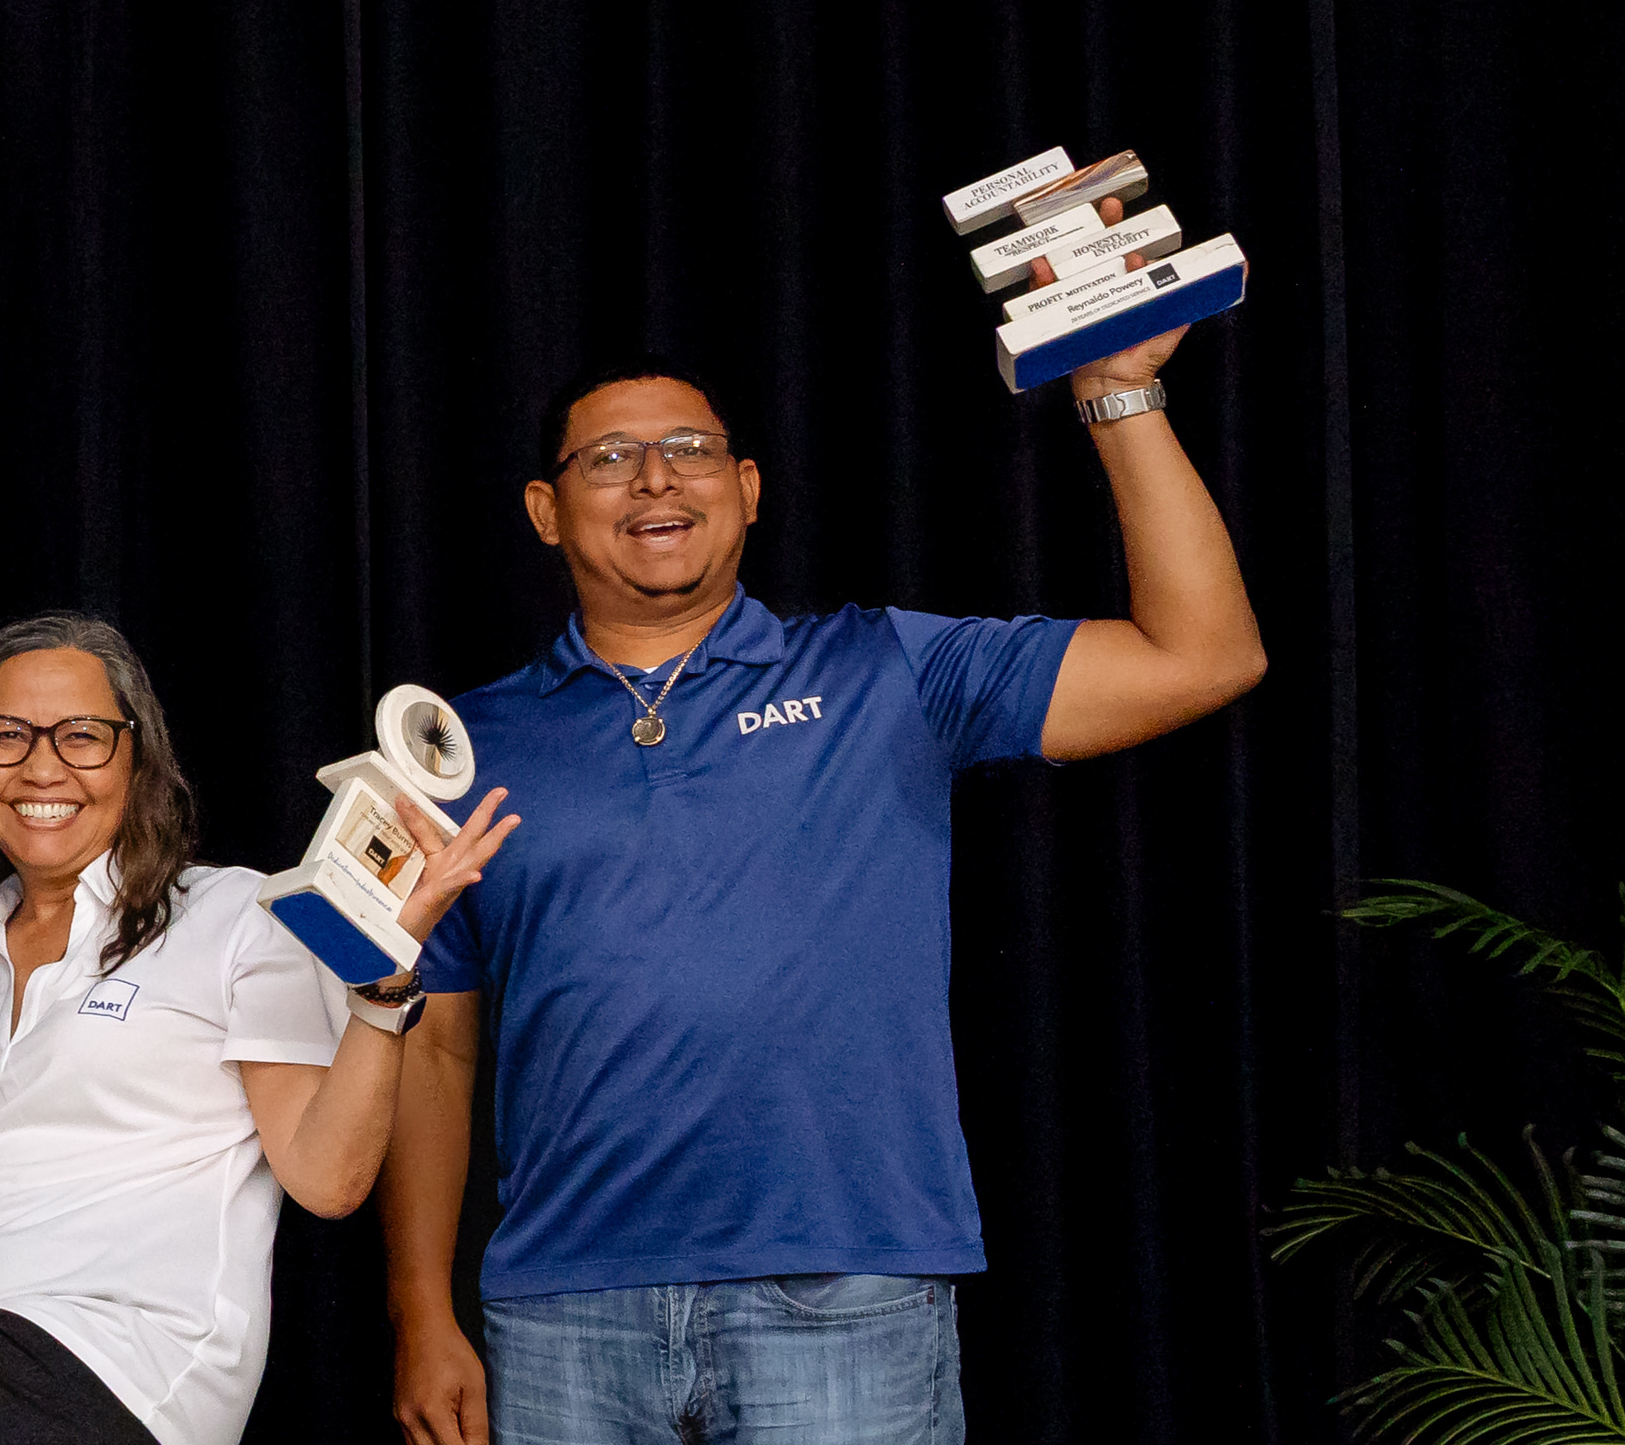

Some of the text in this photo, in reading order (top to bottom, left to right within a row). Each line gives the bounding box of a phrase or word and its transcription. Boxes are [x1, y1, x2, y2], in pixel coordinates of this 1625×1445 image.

[964, 162, 1060, 211] ACCOUNTABILITY
[970, 167, 1031, 198] PERSONAL
[994, 225, 1060, 256] TEAMWORK
[1073, 231, 1123, 258] HONESTY
[1091, 229, 1151, 258] INTEGRITY
[1027, 272, 1117, 313] PROFIT MOTIVATION
[1067, 277, 1144, 314] Reynaldo Powery
[1156, 274, 1176, 286] DART
[737, 696, 823, 735] DART
[370, 805, 393, 830] Tracey
[87, 1000, 123, 1012] DART
